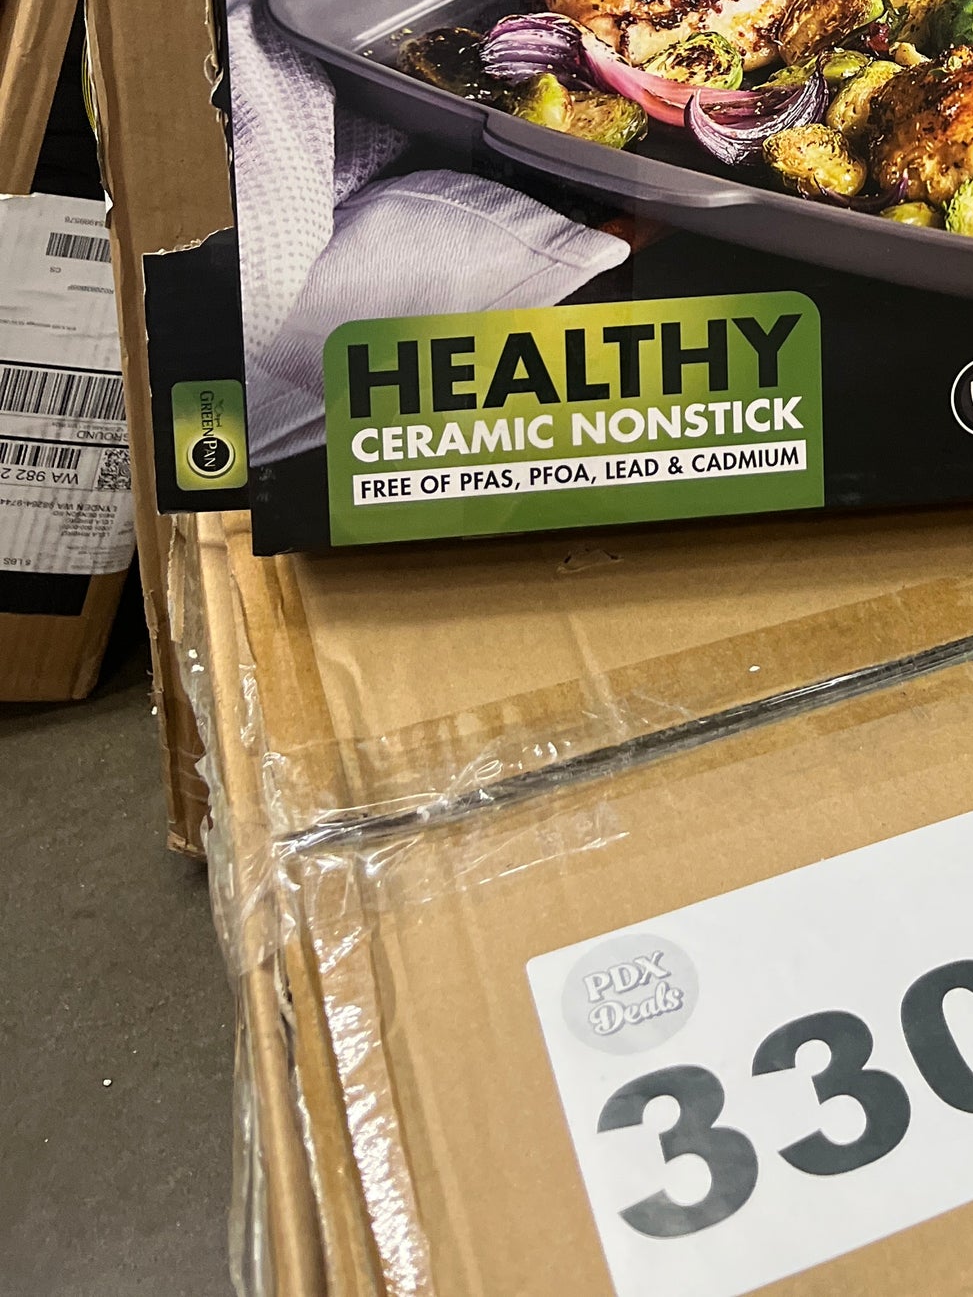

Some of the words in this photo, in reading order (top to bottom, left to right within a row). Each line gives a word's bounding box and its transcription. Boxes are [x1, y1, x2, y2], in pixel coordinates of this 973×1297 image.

[347, 313, 803, 419] HEALTHY
[351, 415, 555, 464] CERAMIC
[572, 396, 804, 447] NONSTICK
[15, 468, 46, 482] 982
[51, 471, 79, 486] WA
[361, 474, 412, 500] FREE
[420, 475, 451, 495] OF
[460, 467, 521, 493] PFAS,
[529, 461, 597, 487] PFOA,
[605, 457, 659, 481] LEAD
[668, 456, 684, 476] &
[691, 445, 800, 474] CADMIUM
[583, 950, 672, 1002] PDX
[588, 981, 684, 1036] Deals
